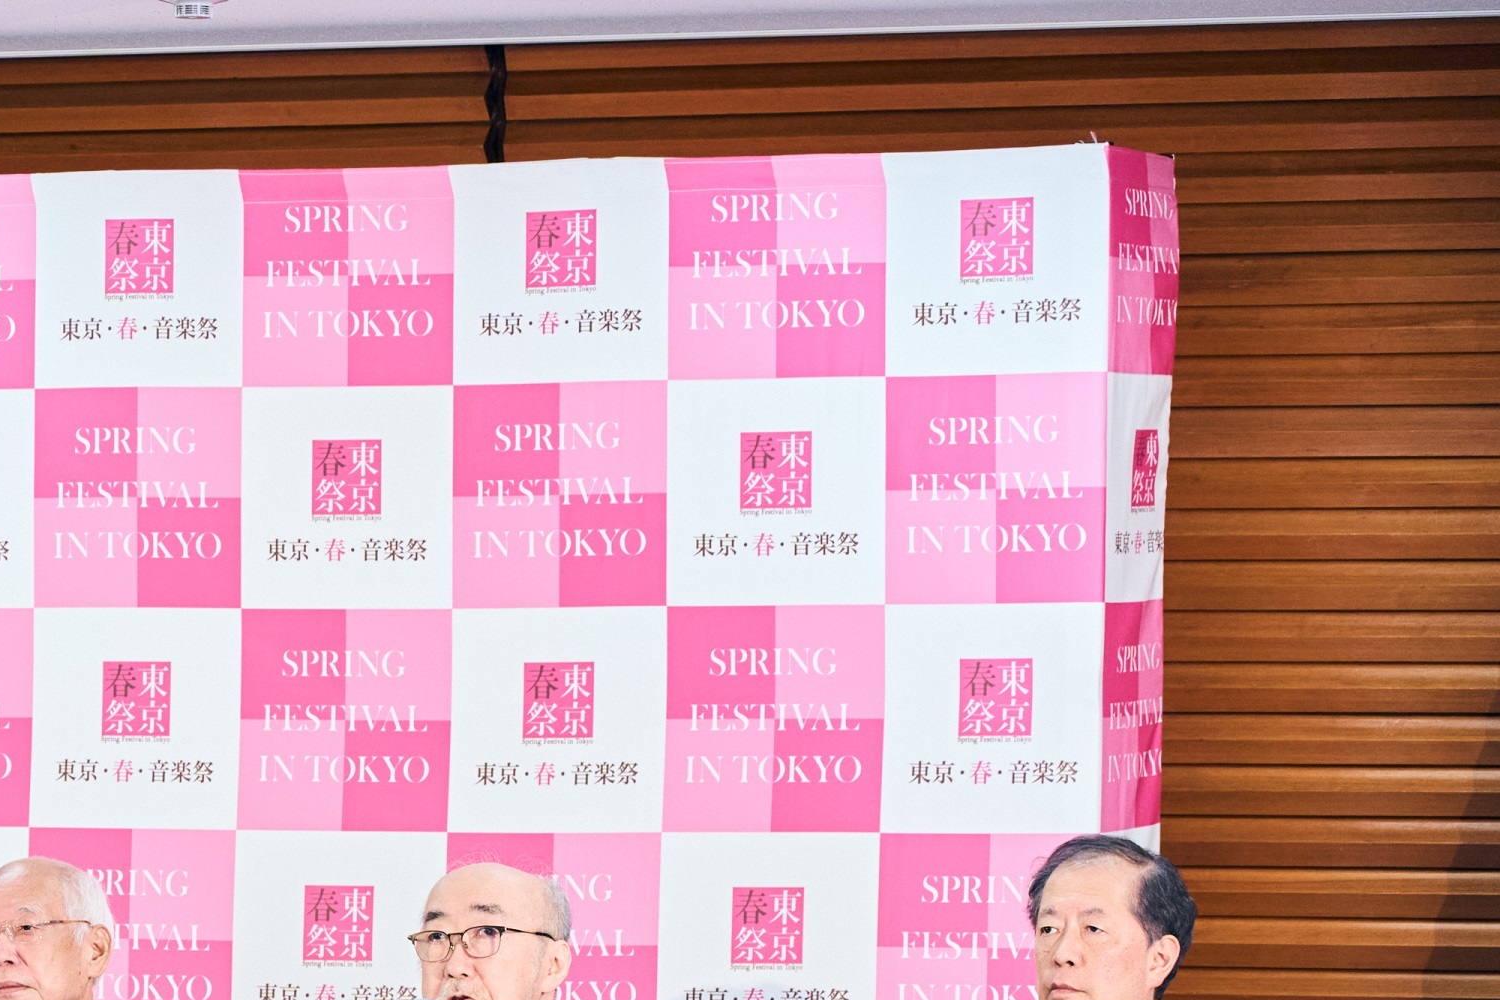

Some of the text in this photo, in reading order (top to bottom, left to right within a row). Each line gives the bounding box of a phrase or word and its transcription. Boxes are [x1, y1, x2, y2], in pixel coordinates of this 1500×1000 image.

[284, 204, 408, 232] SPRING
[712, 191, 839, 222] SPRING
[1125, 187, 1174, 220] SPRING
[266, 258, 430, 288] FESTIVAL
[692, 246, 862, 279] FESTIVAL
[263, 310, 433, 338] IN TOKYO
[479, 308, 643, 337] 東京・春・音楽祭
[689, 299, 865, 331] IN TOKYO
[914, 297, 1082, 327] 東京・春・音楽祭
[1116, 295, 1132, 324] IN
[61, 316, 218, 342] 東京・春・音楽祭
[74, 426, 196, 455] SPRING
[495, 421, 620, 451] SPRING
[928, 414, 1060, 446] SPRING
[56, 480, 218, 509] FESTIVAL
[476, 476, 643, 507] FESTIVAL
[909, 469, 1084, 502] FESTIVAL
[54, 531, 222, 559] IN TOKYO
[268, 537, 427, 562] 東京・春・音楽祭
[473, 529, 647, 559] IN TOKYO
[694, 531, 859, 558] 東京・春・音楽祭
[906, 523, 1088, 555] IN TOKYO
[283, 650, 405, 677] SPRING
[710, 647, 837, 676] SPRING
[1116, 643, 1162, 674] SPRING
[263, 704, 427, 732] FESTIVAL
[690, 703, 859, 732] FESTIVAL
[56, 758, 214, 784] 東京・春・音楽祭
[259, 754, 430, 783] IN TOKYO
[475, 761, 639, 786] 東京・春・音楽祭
[685, 755, 862, 783] IN TOKYO
[910, 759, 1078, 785] 東京・春・音楽祭
